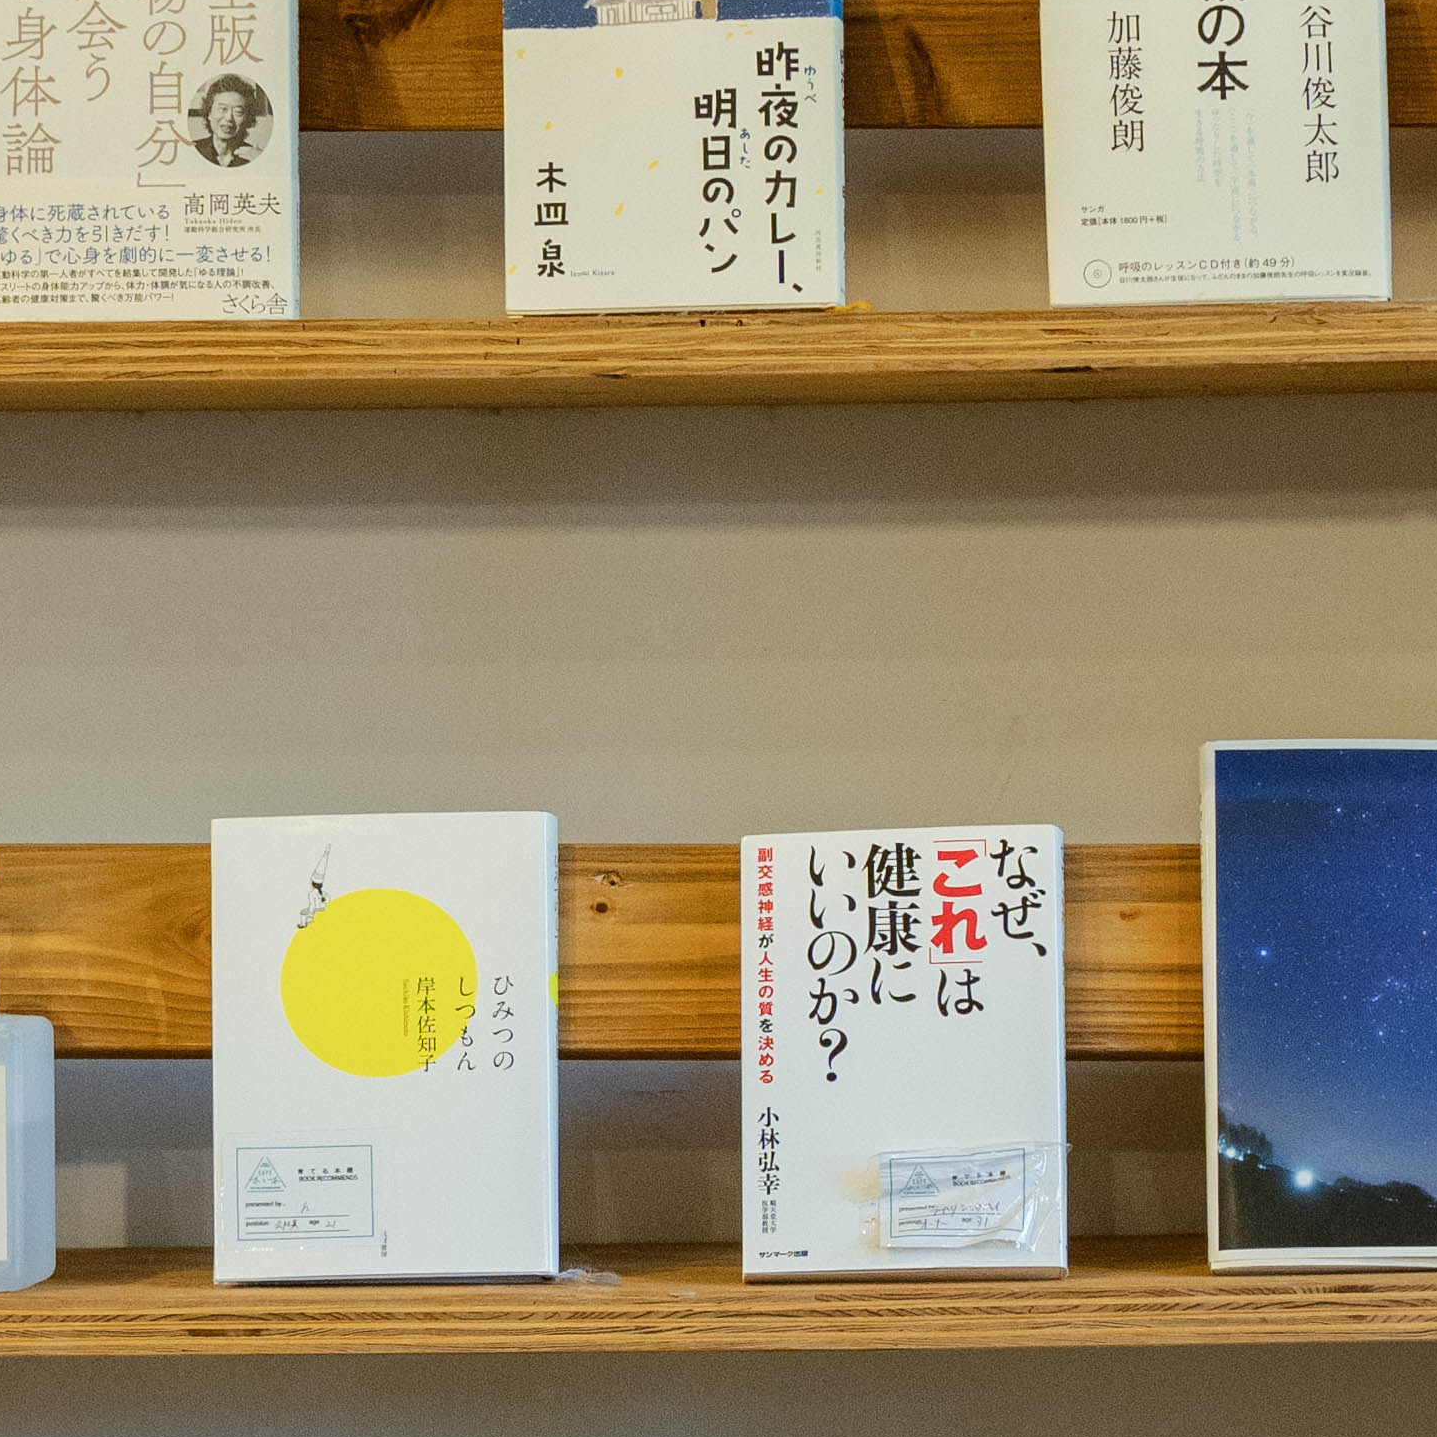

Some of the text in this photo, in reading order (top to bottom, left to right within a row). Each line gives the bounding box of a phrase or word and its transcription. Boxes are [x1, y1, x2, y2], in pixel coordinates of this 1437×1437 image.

[1107, 10, 1145, 153] 加藤俊朗
[1299, 4, 1340, 184] 谷川俊太郎
[183, 193, 282, 217] 高岡英夫
[534, 162, 569, 278] 木皿泉
[694, 88, 742, 274] 明日のパン
[755, 41, 804, 294] 昨夜のカレー、
[221, 294, 288, 316] さくら舎
[862, 842, 923, 1006] 健康に
[929, 839, 987, 1017] 「これ」は
[990, 839, 1047, 958] なぜ、
[416, 976, 437, 1073] 岸本佐知子
[456, 975, 477, 1072] しつもん
[493, 974, 514, 1071] ひみつの
[757, 847, 774, 1085] 副交感神経が人生の質を決める
[757, 1107, 780, 1196] 小林弘幸
